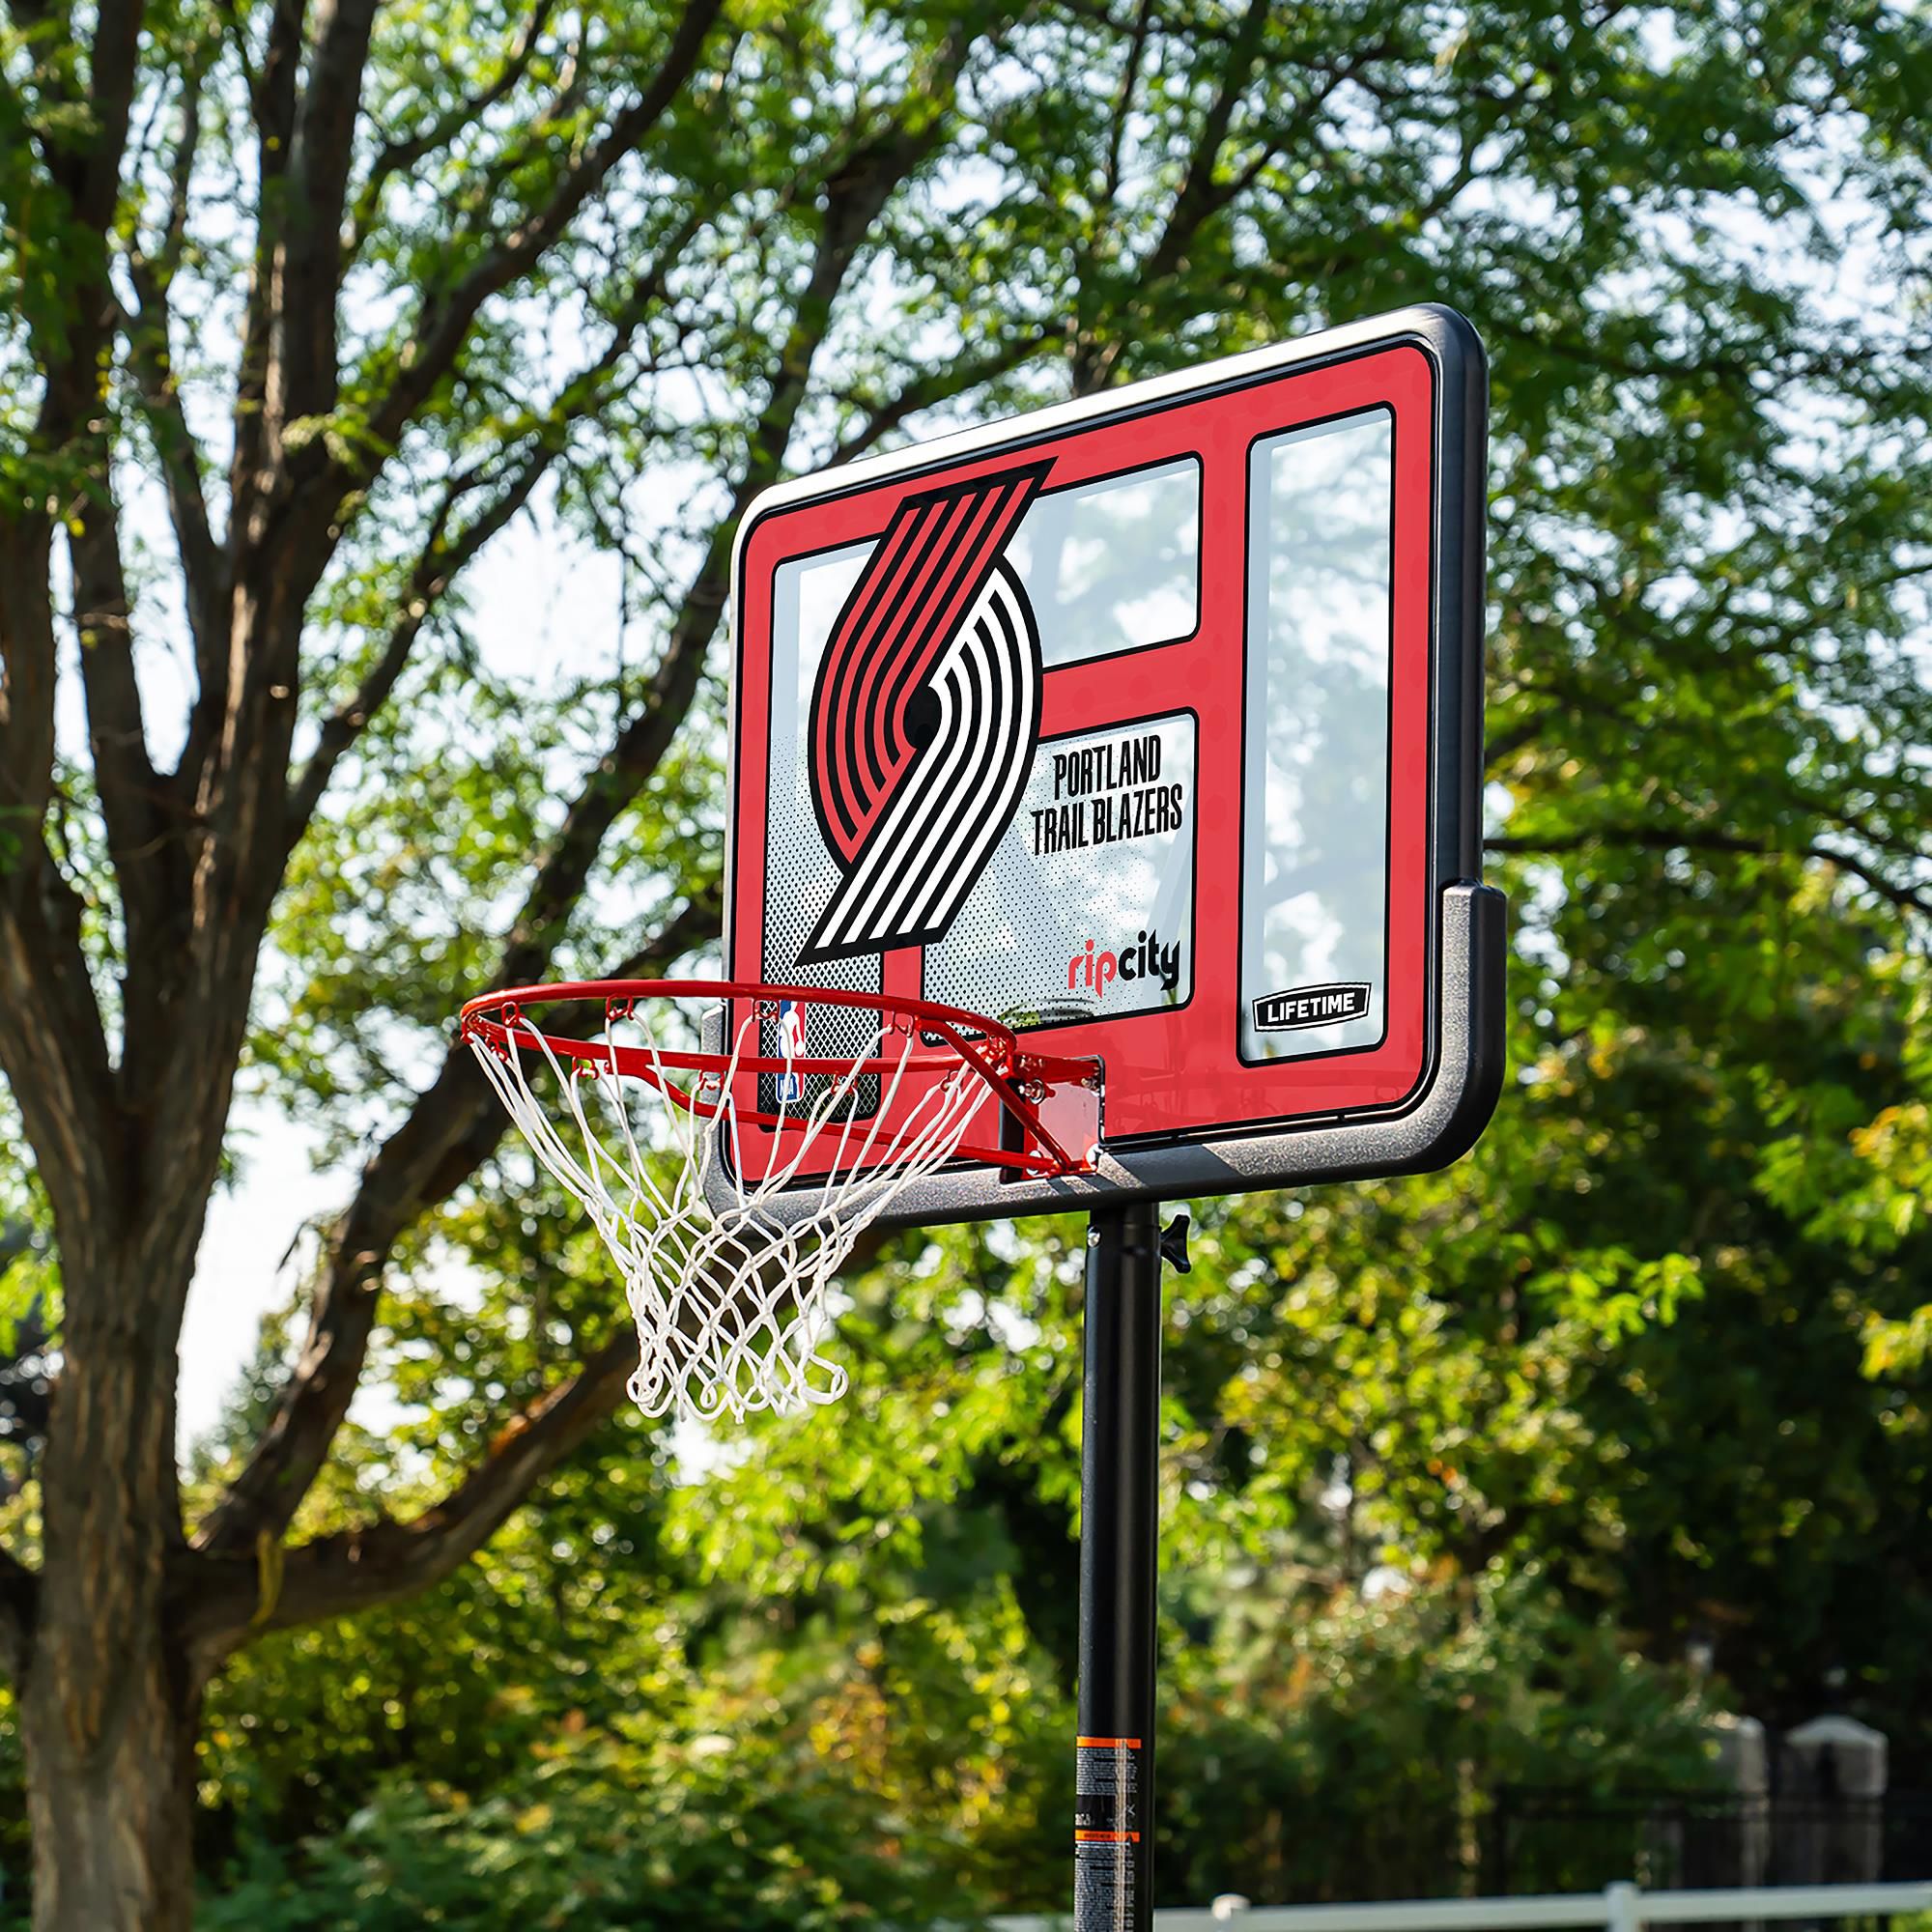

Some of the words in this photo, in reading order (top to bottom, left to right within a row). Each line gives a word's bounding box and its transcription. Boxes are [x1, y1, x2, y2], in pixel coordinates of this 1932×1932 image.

[1052, 734, 1161, 800] PORTLAND
[1030, 801, 1089, 856] TRAIL
[1091, 783, 1182, 845] BLAZERS
[1267, 992, 1355, 1023] LIFETIME
